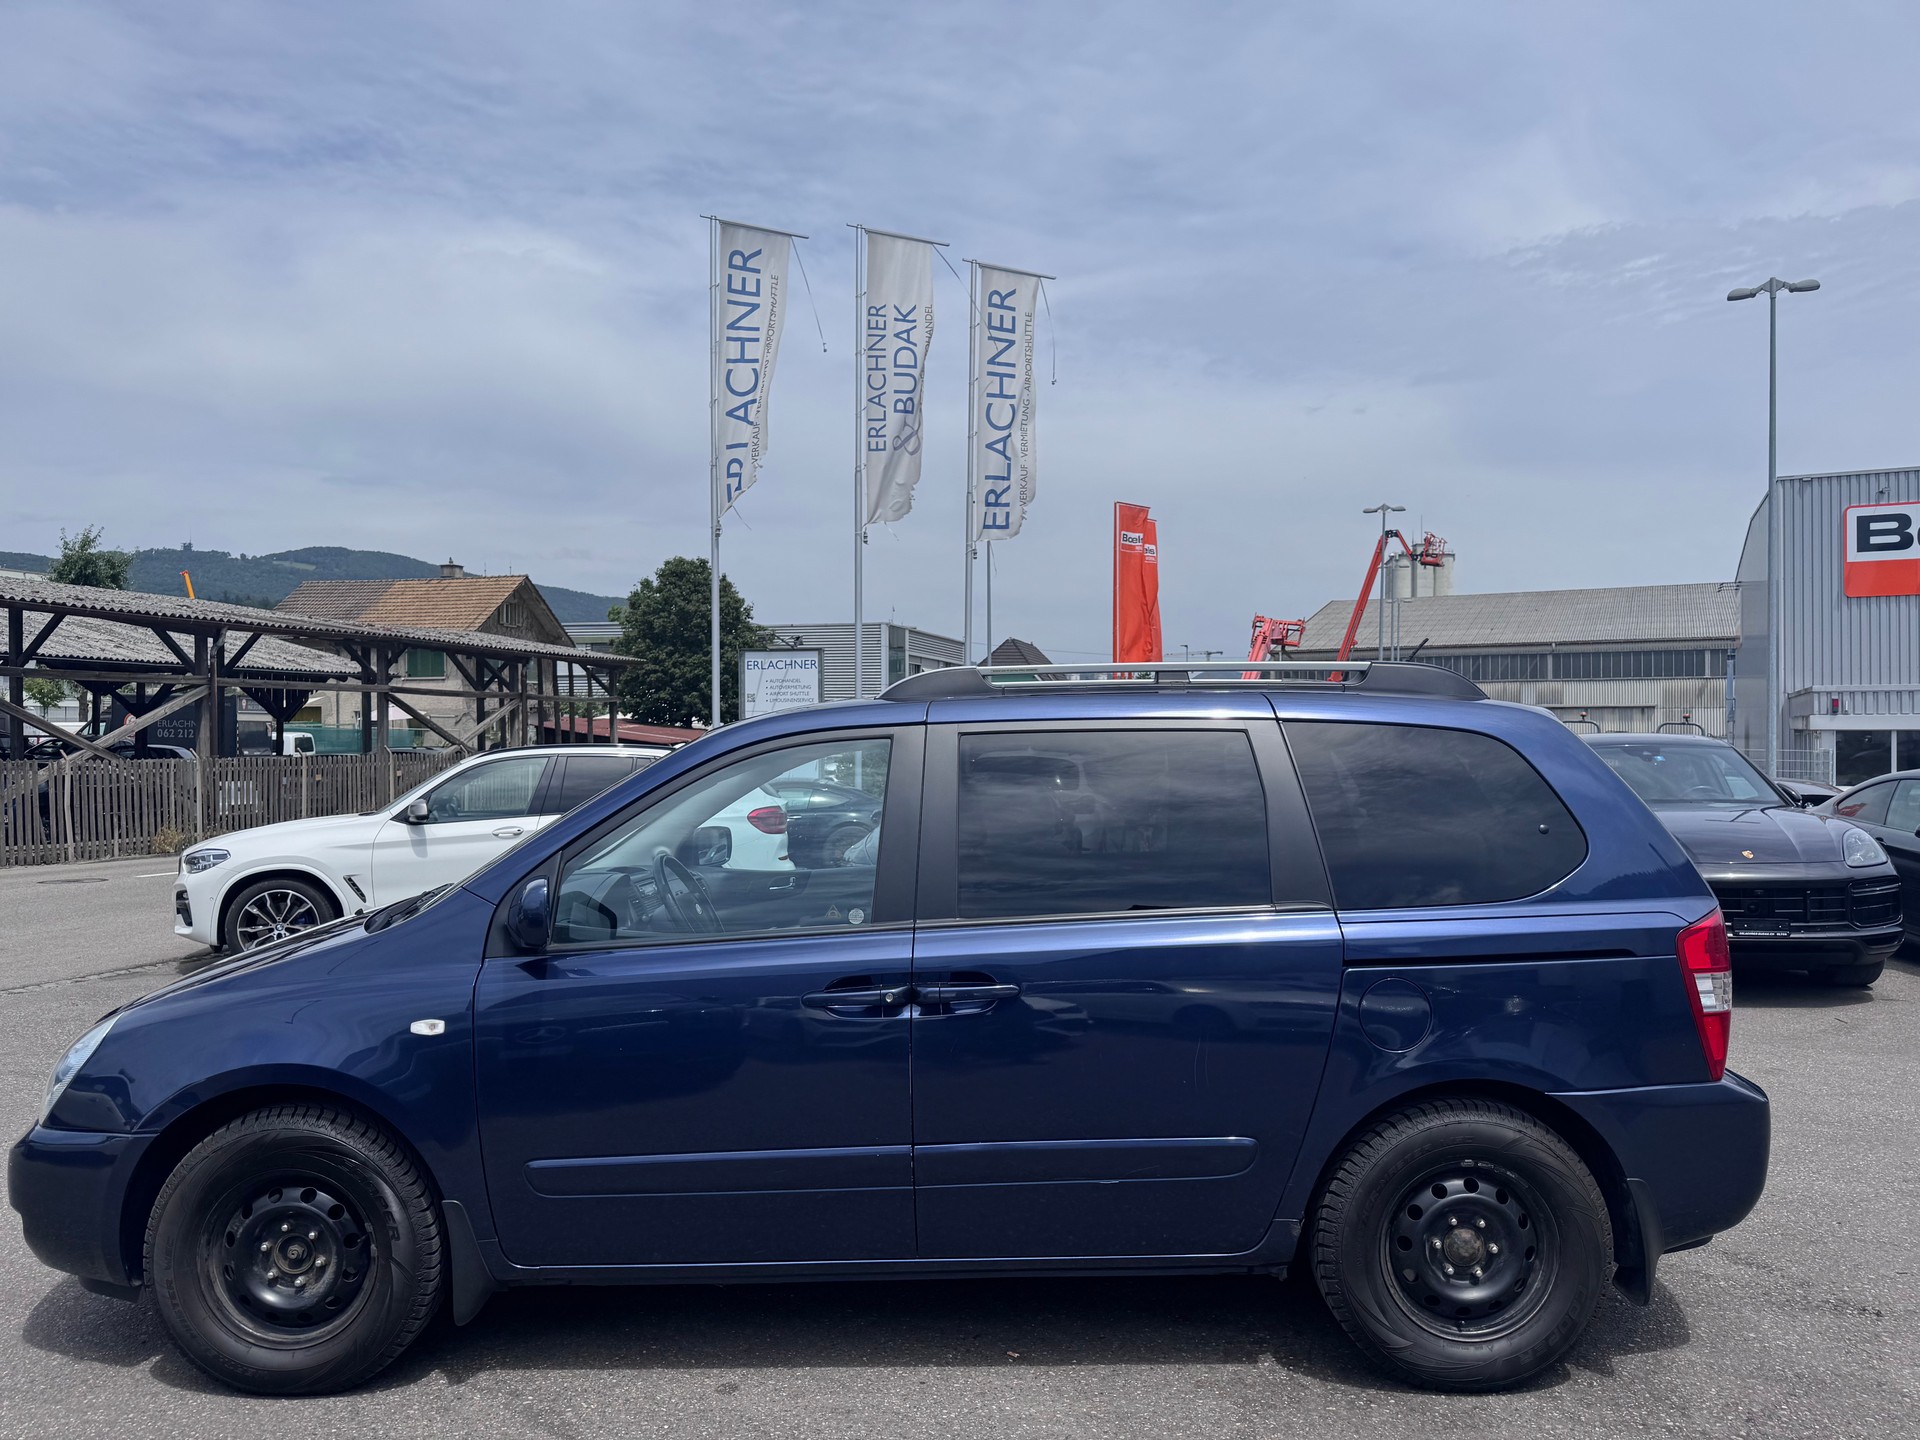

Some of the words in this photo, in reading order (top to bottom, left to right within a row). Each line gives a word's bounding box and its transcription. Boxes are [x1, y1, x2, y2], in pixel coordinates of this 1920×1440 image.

[867, 303, 887, 453] ERLACHNER
[893, 304, 918, 415] BUDAK
[1023, 311, 1033, 393] AIRPORTSHUTTLE
[983, 288, 1017, 531] ERLACHNER
[1020, 398, 1031, 459] VERMIETUNG
[751, 421, 761, 465] VERKAUF
[1019, 464, 1028, 507] VERKAUF
[746, 659, 818, 670] ERLACHNER
[157, 719, 197, 728] ERLACHN
[157, 728, 175, 738] 062
[177, 728, 195, 738] 212
